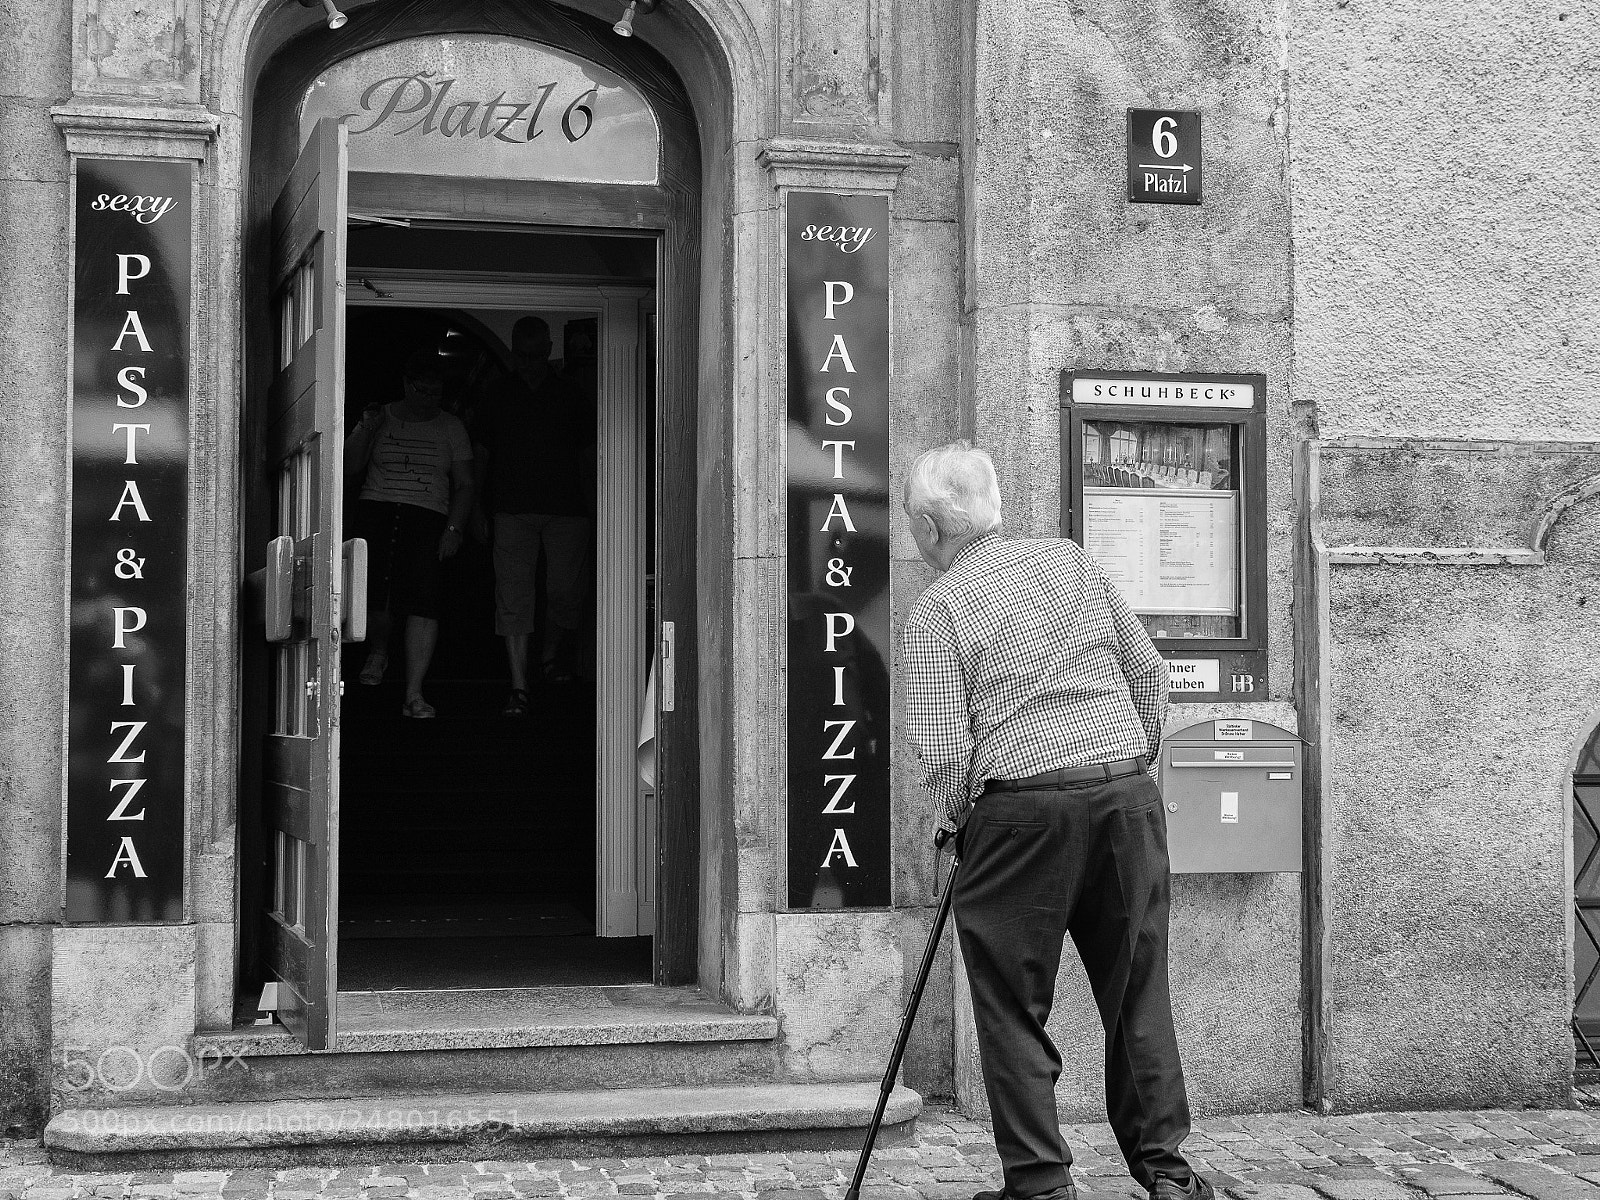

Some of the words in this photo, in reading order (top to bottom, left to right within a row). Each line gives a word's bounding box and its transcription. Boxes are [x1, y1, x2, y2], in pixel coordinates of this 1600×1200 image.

[339, 71, 558, 144] Platzl
[561, 88, 598, 143] 6
[1152, 116, 1178, 159] 6
[1144, 172, 1188, 194] Platzl
[91, 193, 179, 225] sexy
[801, 224, 878, 254] sexy
[109, 253, 154, 522] PASTA
[819, 280, 858, 533] PASTA
[114, 548, 146, 579] &
[825, 557, 853, 588] &
[104, 606, 148, 879] PIZZA
[820, 612, 860, 869] PIZZA
